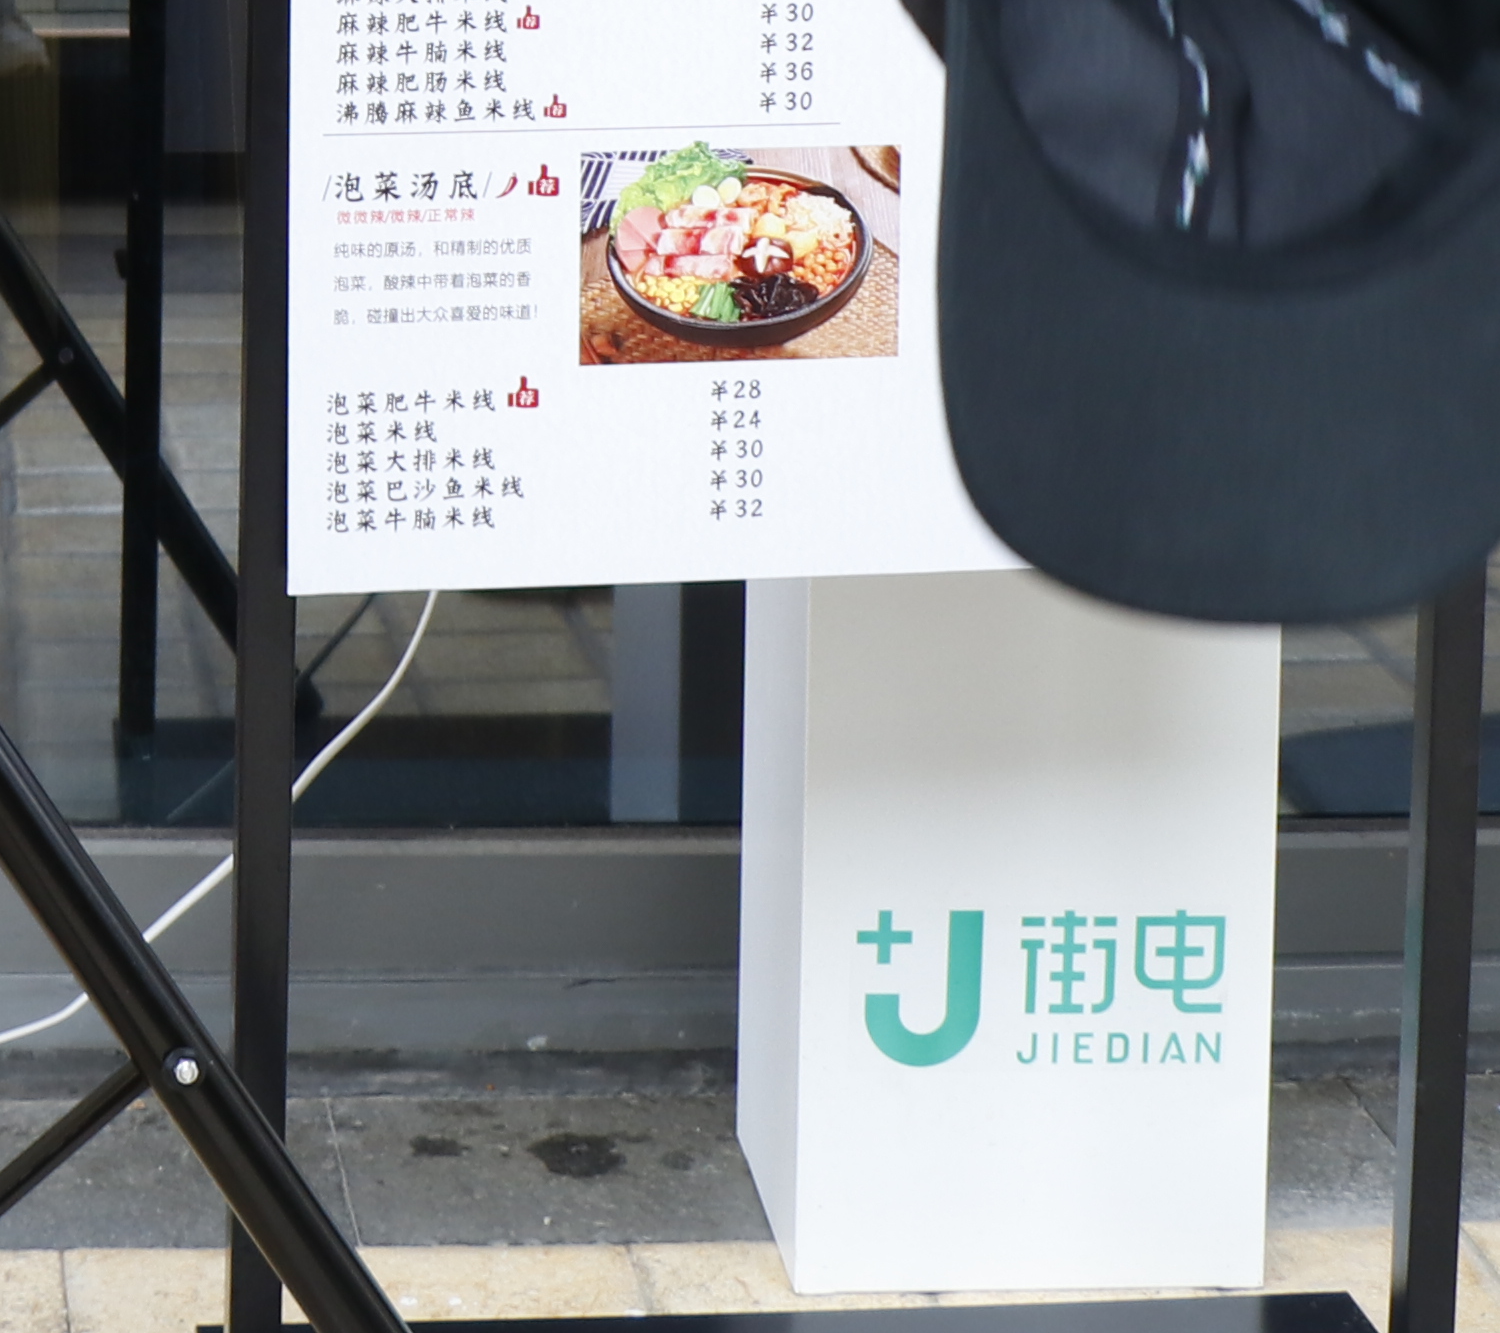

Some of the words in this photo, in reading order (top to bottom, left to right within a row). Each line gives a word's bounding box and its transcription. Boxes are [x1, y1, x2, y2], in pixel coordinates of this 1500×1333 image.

[336, 9, 508, 36] 麻辣肥牛米线
[336, 39, 507, 66] 麻辣牛腩米线
[336, 69, 507, 96] 麻辣肥肠米线
[337, 98, 536, 125] 沸腾麻辣鱼米线
[327, 388, 496, 417] 泡菜肥牛米线
[327, 419, 438, 446] 泡菜米线
[327, 447, 496, 475] 泡菜大排米线
[327, 475, 525, 505] 泡菜巴沙鱼米线
[327, 505, 495, 534] 泡菜牛腩米线
[1021, 910, 1226, 1014] 街电
[1017, 1033, 1223, 1064] JIEDIAN
